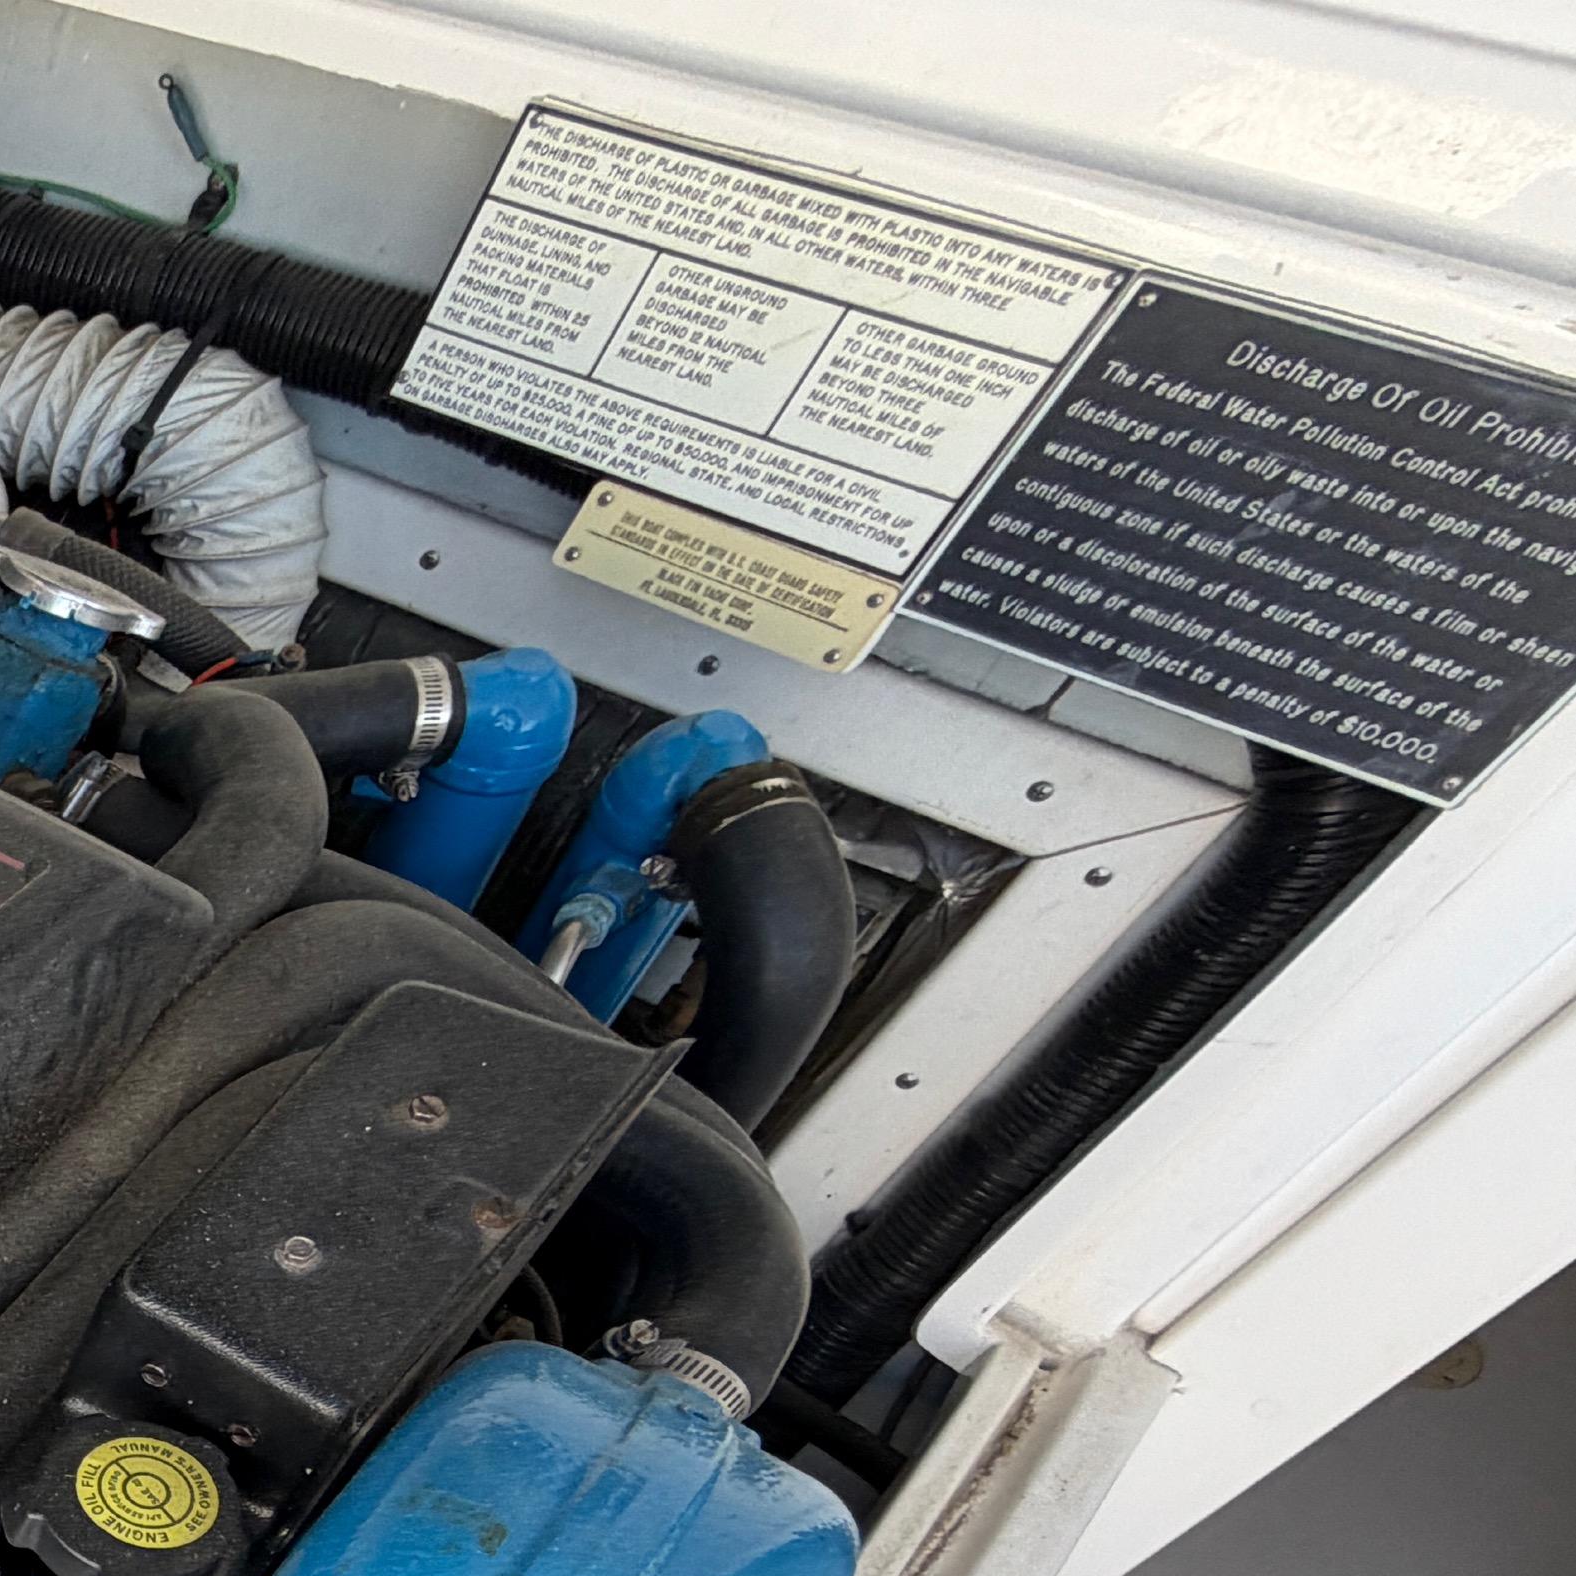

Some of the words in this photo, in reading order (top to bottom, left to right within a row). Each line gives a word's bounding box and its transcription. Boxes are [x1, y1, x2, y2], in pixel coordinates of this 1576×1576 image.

[522, 139, 599, 173] PROHIBITED.
[607, 163, 635, 183] THE
[634, 171, 711, 204] DISCHARGE
[710, 193, 732, 209] OF
[729, 199, 757, 219] ALL
[760, 208, 828, 237] GARBAGE
[825, 225, 844, 242] IS
[844, 231, 932, 266] PROHIBITED
[933, 257, 953, 273] IN
[952, 261, 986, 282] THE
[983, 271, 1074, 306] NAVIGABLE
[538, 121, 564, 141] THE
[562, 130, 636, 162] DISCHARGE
[634, 150, 656, 166] OF
[653, 156, 710, 183] PLASTIC
[709, 171, 732, 189] OR
[731, 178, 798, 208] GARBAGE
[796, 196, 843, 220] MIXED
[843, 209, 882, 231] WITH
[879, 219, 944, 248] PLASTIC
[943, 237, 982, 259] INTO
[979, 248, 1018, 268] ANY
[1015, 257, 1083, 287] WATERS
[1081, 275, 1105, 291] IS
[842, 336, 862, 354] TO
[861, 343, 903, 366] LESS
[902, 355, 945, 378] THAN
[943, 368, 977, 388] ONE
[974, 378, 1014, 400] INCH
[856, 321, 906, 346] OTHER
[905, 336, 976, 367] GARBAGE
[975, 358, 1039, 385] GROUND
[1226, 340, 1368, 402] Discharge
[1371, 383, 1420, 412] Of
[1418, 396, 1472, 428] Oil
[1466, 411, 1576, 466] Prohibi
[1066, 398, 1160, 442] discharge
[1159, 430, 1191, 448] of
[1187, 437, 1222, 457] oil
[1217, 447, 1244, 465] or
[1243, 452, 1287, 481] oily
[1286, 469, 1349, 498] waste
[1349, 484, 1397, 513] into
[1397, 503, 1426, 521] or
[1426, 512, 1482, 538] upon
[1482, 526, 1524, 551] the
[1101, 360, 1139, 387] The
[1139, 372, 1224, 410] Federal
[1221, 395, 1288, 430] Water
[1287, 417, 1389, 461] Pollution
[1390, 447, 1481, 487] Control
[1473, 473, 1524, 501] Act
[1014, 477, 1116, 519] contiguous
[1115, 509, 1164, 535] zone
[1163, 522, 1191, 541] if
[1185, 532, 1236, 558] such
[1236, 546, 1336, 591] discharge
[1335, 581, 1411, 615] causes
[1410, 606, 1431, 622] a
[1430, 608, 1478, 635] film
[1477, 627, 1507, 644] or
[1506, 636, 1576, 667] sheen
[1043, 441, 1108, 471] waters
[1108, 461, 1139, 479] of
[1134, 467, 1170, 492] the
[1172, 478, 1244, 513] United
[1241, 498, 1316, 537] States
[1315, 527, 1343, 544] or
[1343, 533, 1381, 557] the
[1382, 548, 1458, 581] waters
[1459, 572, 1493, 590] of
[1489, 579, 1530, 604] the
[937, 574, 990, 609] water.
[998, 595, 1083, 639] Violators
[1080, 629, 1116, 650] are
[1115, 642, 1190, 676] subject
[1189, 665, 1214, 684] to
[1214, 676, 1232, 692] a
[1227, 682, 1311, 719] penalty
[1309, 709, 1340, 726] of
[961, 546, 1025, 576] causes
[1025, 568, 1041, 583] a
[1041, 573, 1103, 604] sludge
[1103, 594, 1130, 611] or
[1129, 604, 1214, 641] emulsion
[1213, 629, 1294, 668] beneath
[1294, 656, 1333, 681] the
[1332, 673, 1415, 709] surface
[1415, 701, 1450, 718] of
[1444, 708, 1483, 732] the
[987, 512, 1033, 537] upon
[1033, 527, 1058, 544] or
[1057, 536, 1074, 551] a
[1075, 539, 1198, 592] discoloration
[1198, 582, 1229, 600] of
[1224, 588, 1260, 612] the
[1261, 604, 1342, 639] surface
[1342, 630, 1375, 648] of
[1370, 635, 1410, 661] the
[1410, 653, 1475, 682] water
[1474, 674, 1504, 691] or
[80, 1462, 102, 1489] FILL
[83, 1491, 106, 1516] OIL
[109, 1442, 174, 1459] MANUAL
[174, 1455, 211, 1510] OWNER'S
[101, 1515, 170, 1544] ENGINE
[184, 1510, 208, 1533] SEE
